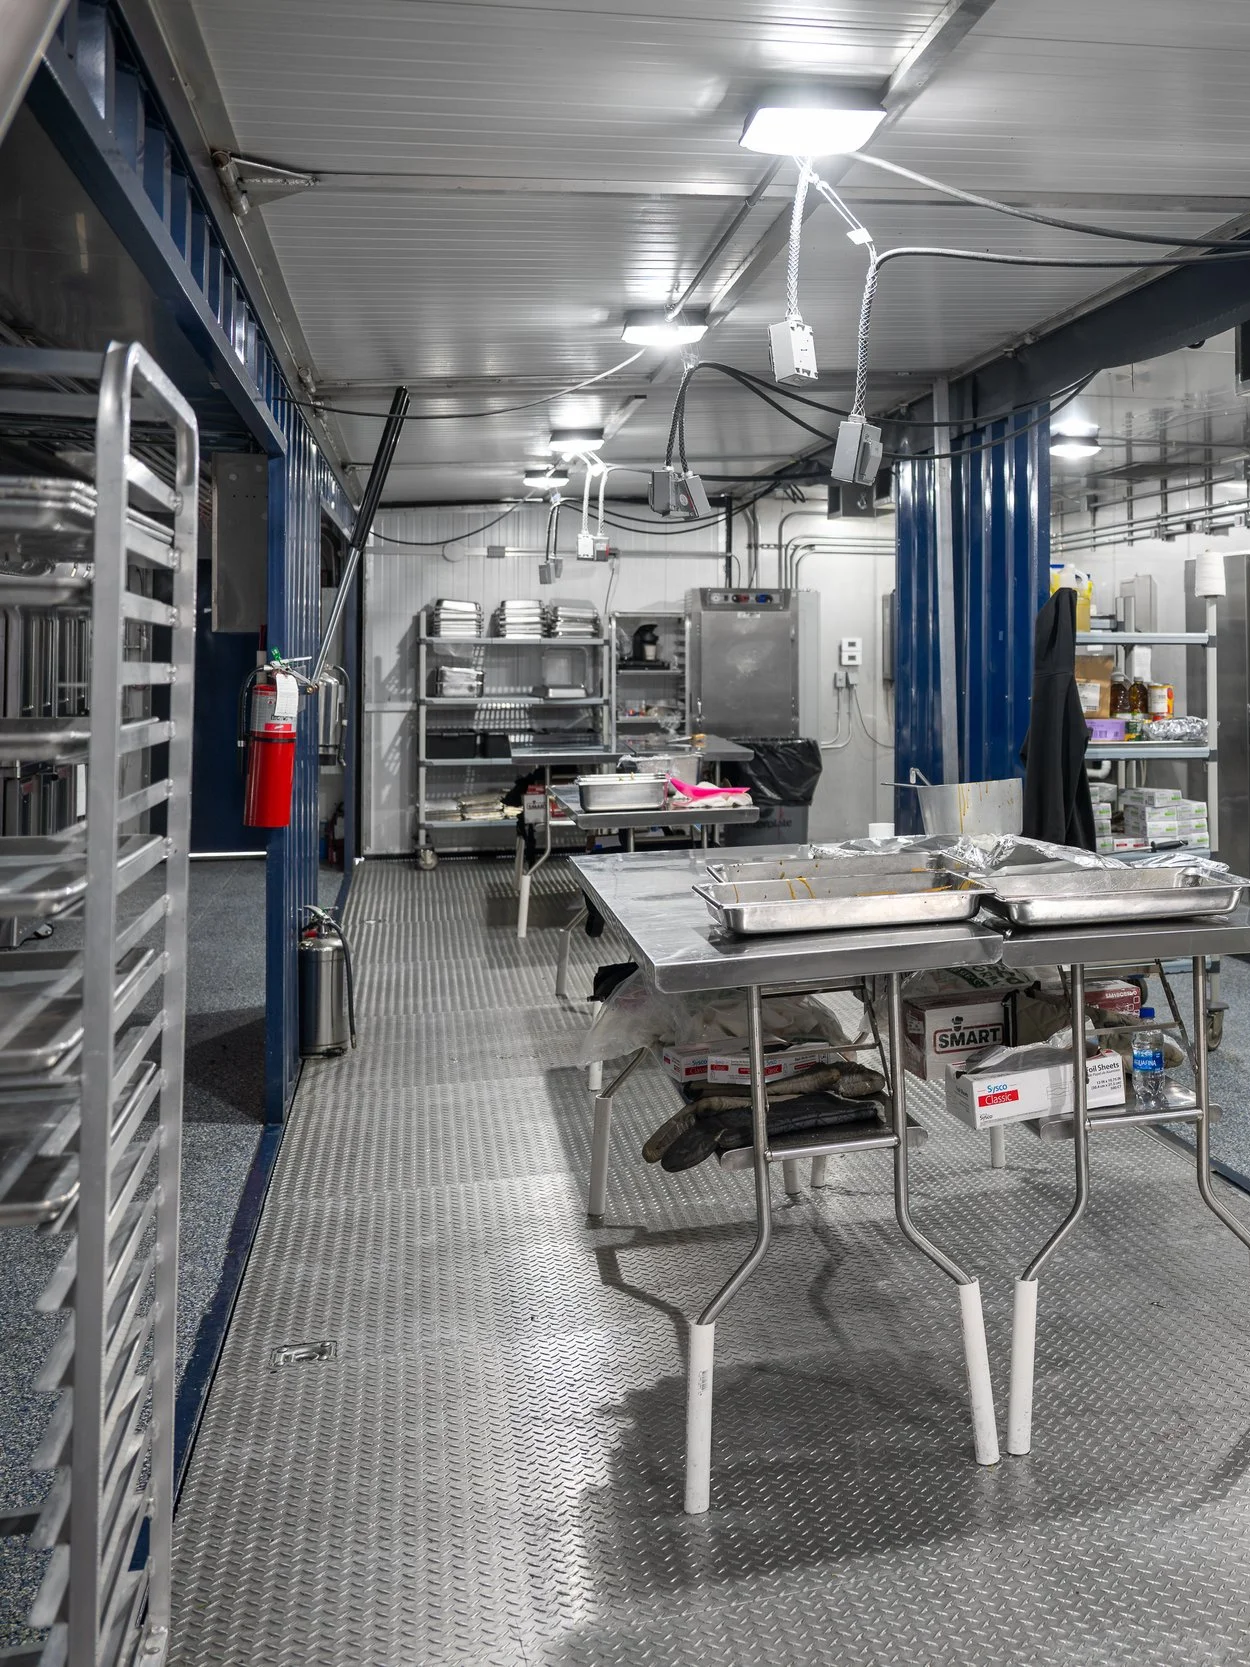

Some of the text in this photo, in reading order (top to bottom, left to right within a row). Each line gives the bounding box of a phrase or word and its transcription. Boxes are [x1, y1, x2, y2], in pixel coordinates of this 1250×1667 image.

[938, 1028, 1000, 1048] SMART
[1097, 1063, 1119, 1071] Sheets
[987, 1083, 1008, 1093] Sysco
[985, 1092, 1013, 1105] Classic
